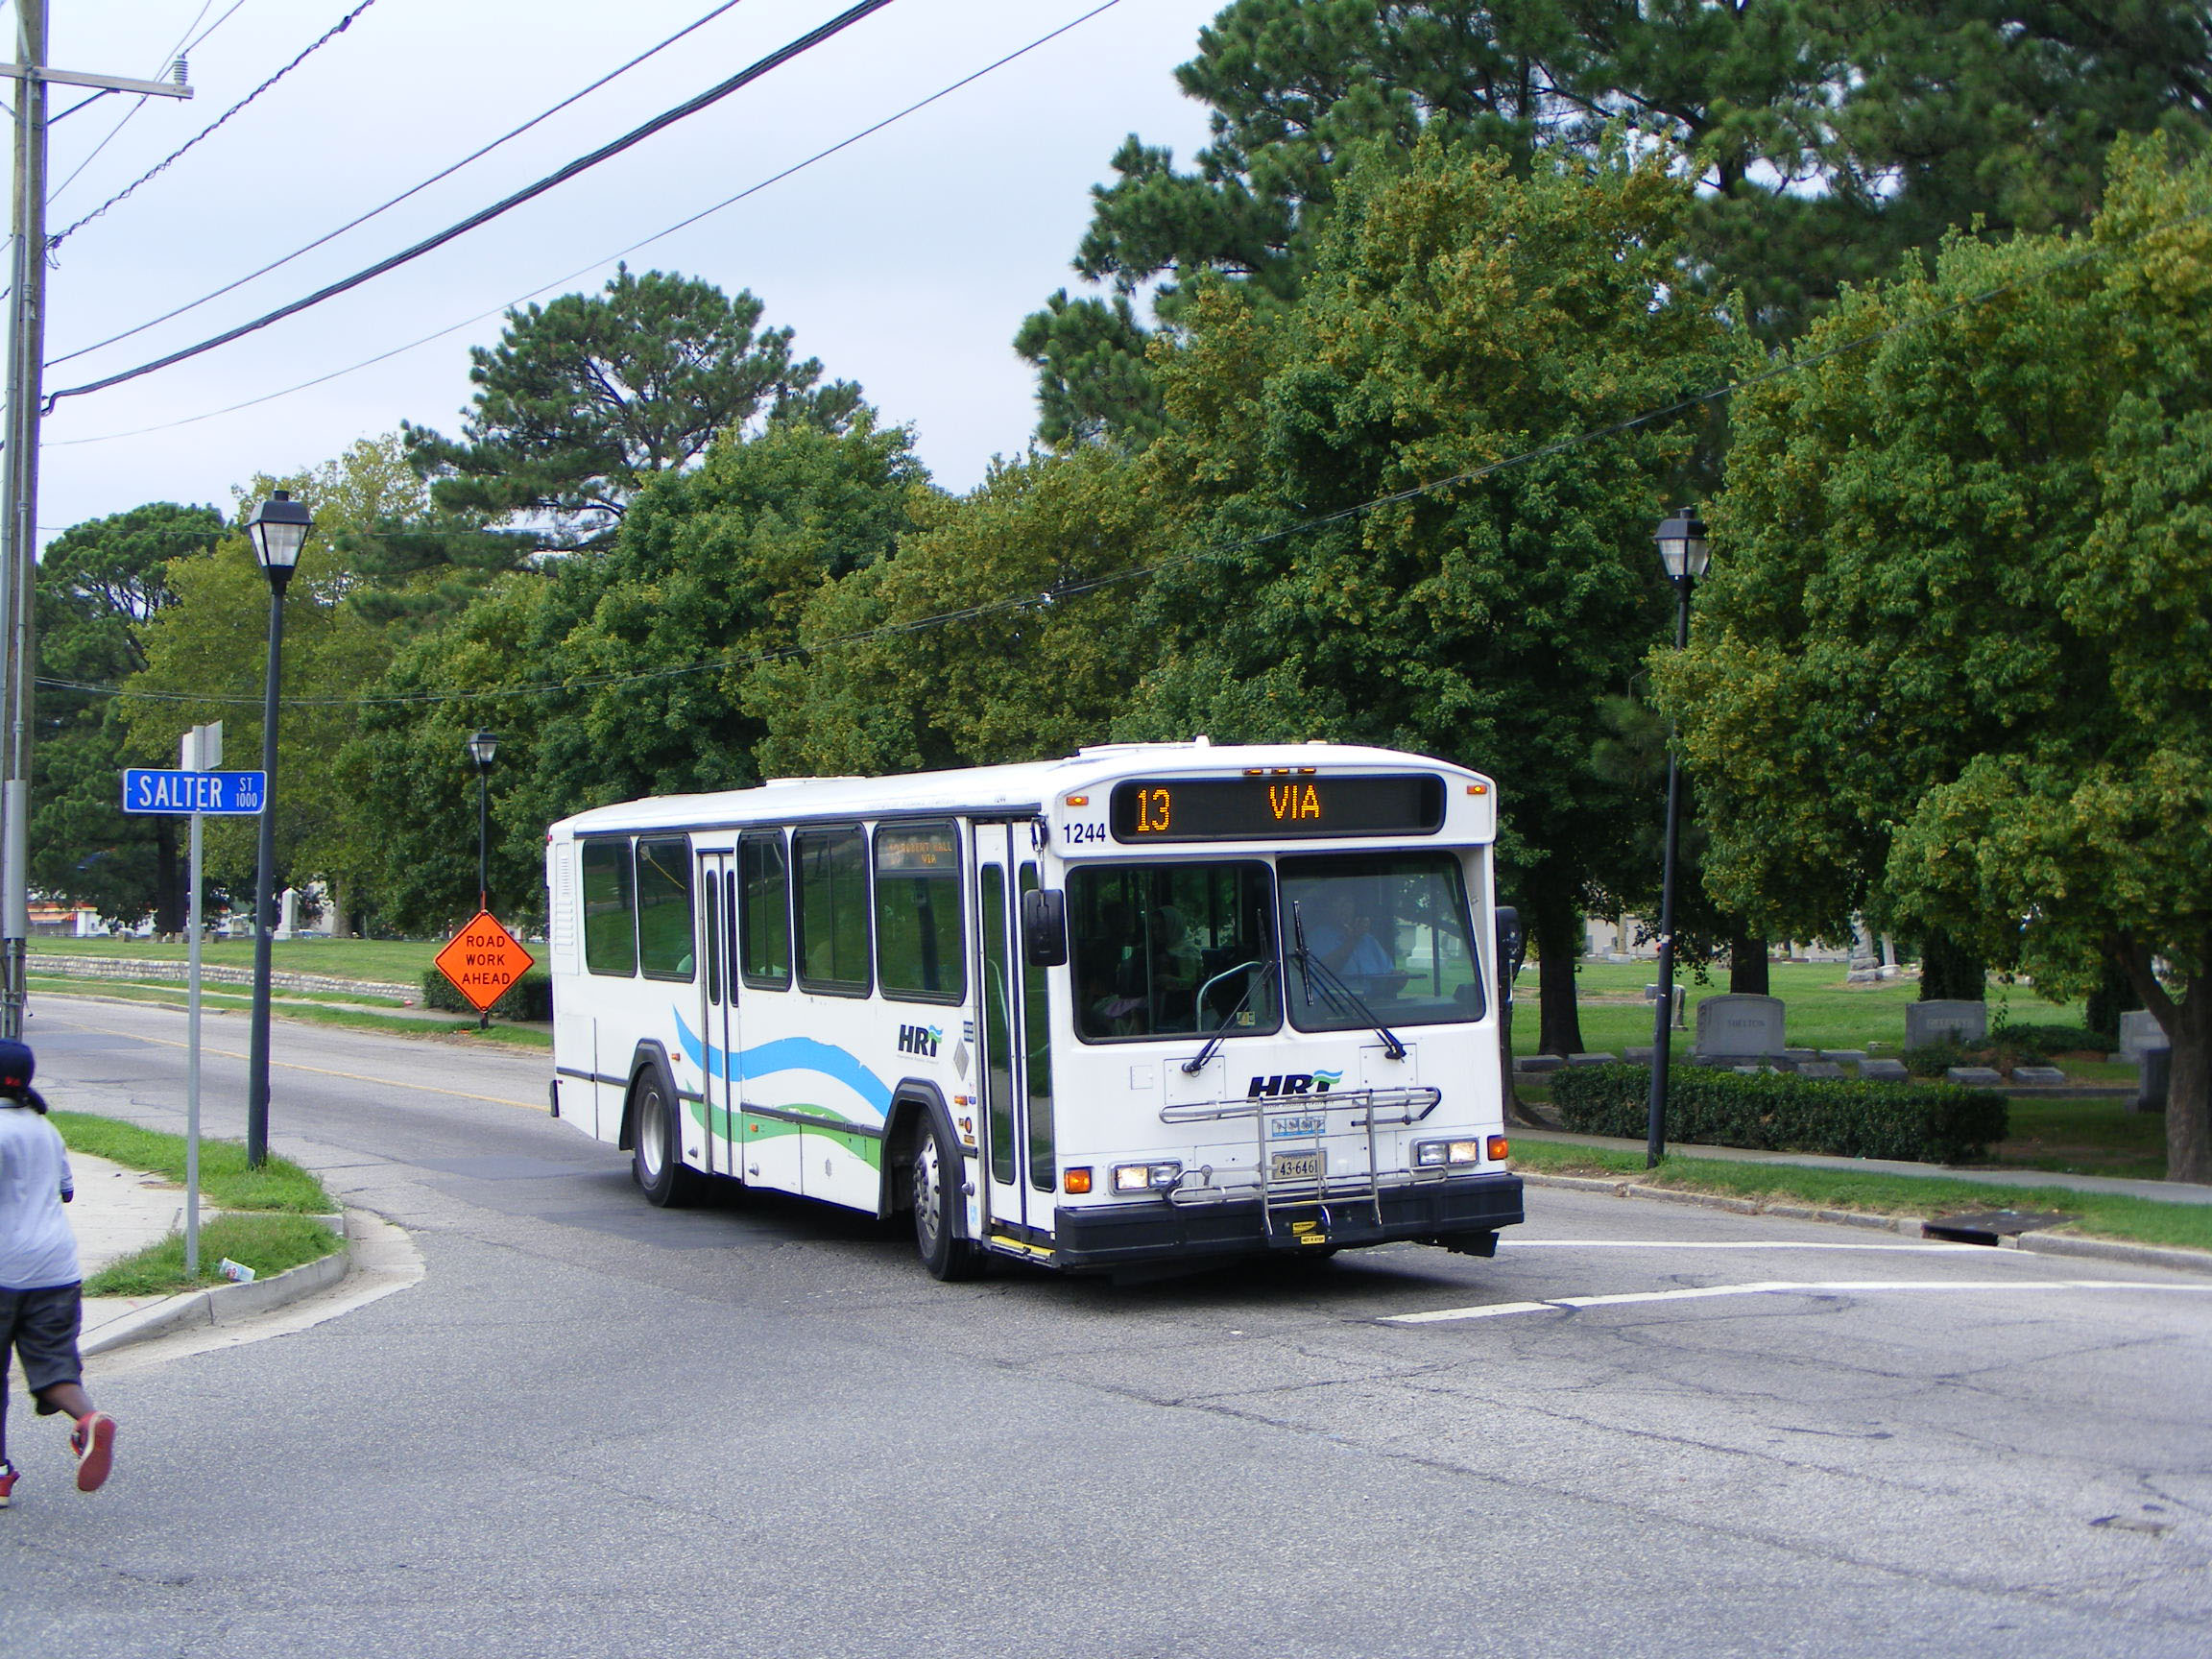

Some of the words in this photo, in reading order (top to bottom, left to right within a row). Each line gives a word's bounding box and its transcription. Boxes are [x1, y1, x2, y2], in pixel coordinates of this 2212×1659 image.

[138, 775, 223, 807] SALTER
[239, 777, 252, 792] ST
[235, 792, 257, 807] 1000
[1137, 789, 1170, 831] 13
[1269, 784, 1320, 819] VIA
[1064, 823, 1106, 843] 1244
[466, 935, 505, 948] ROAD
[466, 954, 505, 966] WORK
[462, 973, 511, 985] AHEAD
[898, 1023, 943, 1058] HRT
[1247, 1070, 1343, 1097] HRT
